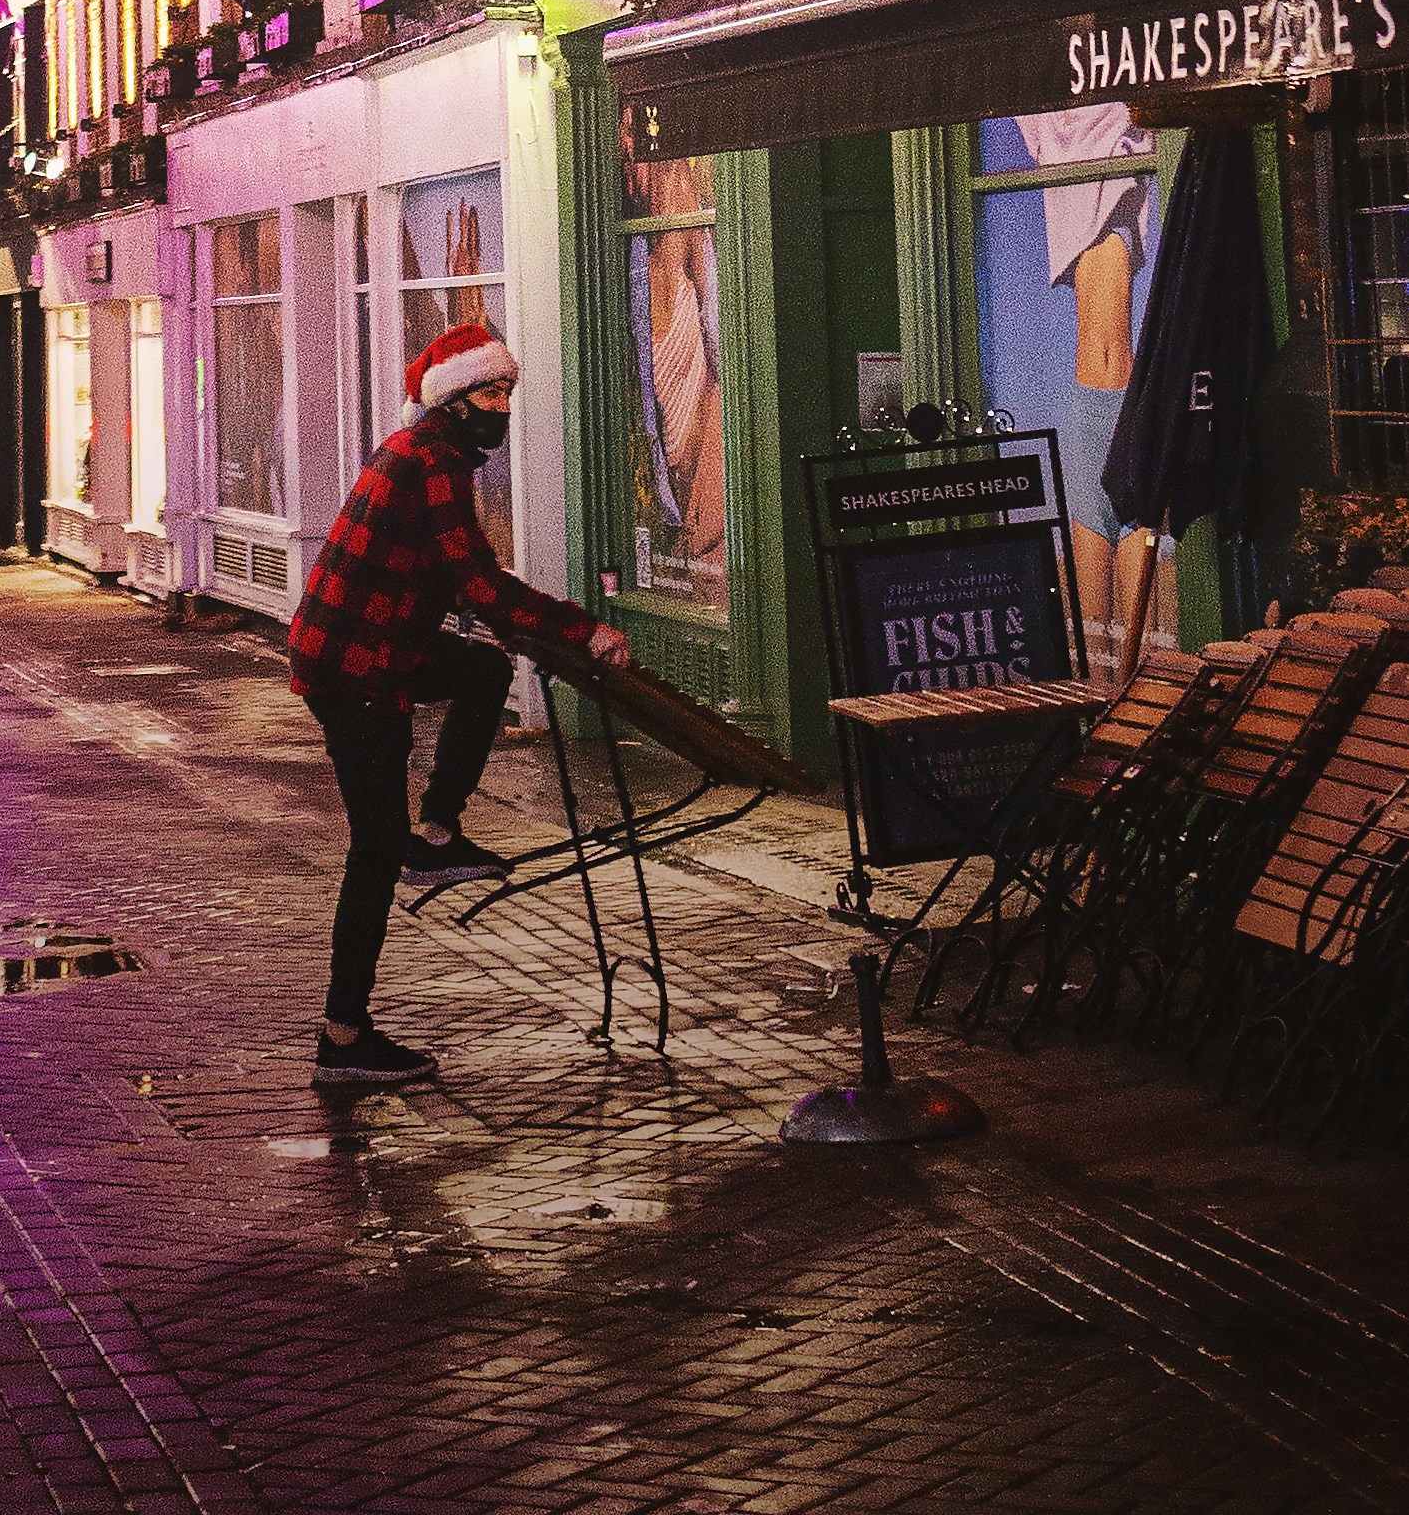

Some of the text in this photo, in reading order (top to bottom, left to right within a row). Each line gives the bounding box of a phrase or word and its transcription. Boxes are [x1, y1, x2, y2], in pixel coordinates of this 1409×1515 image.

[841, 475, 1030, 512] SHAKESPEARES HEAD
[882, 606, 1026, 667] FISH &
